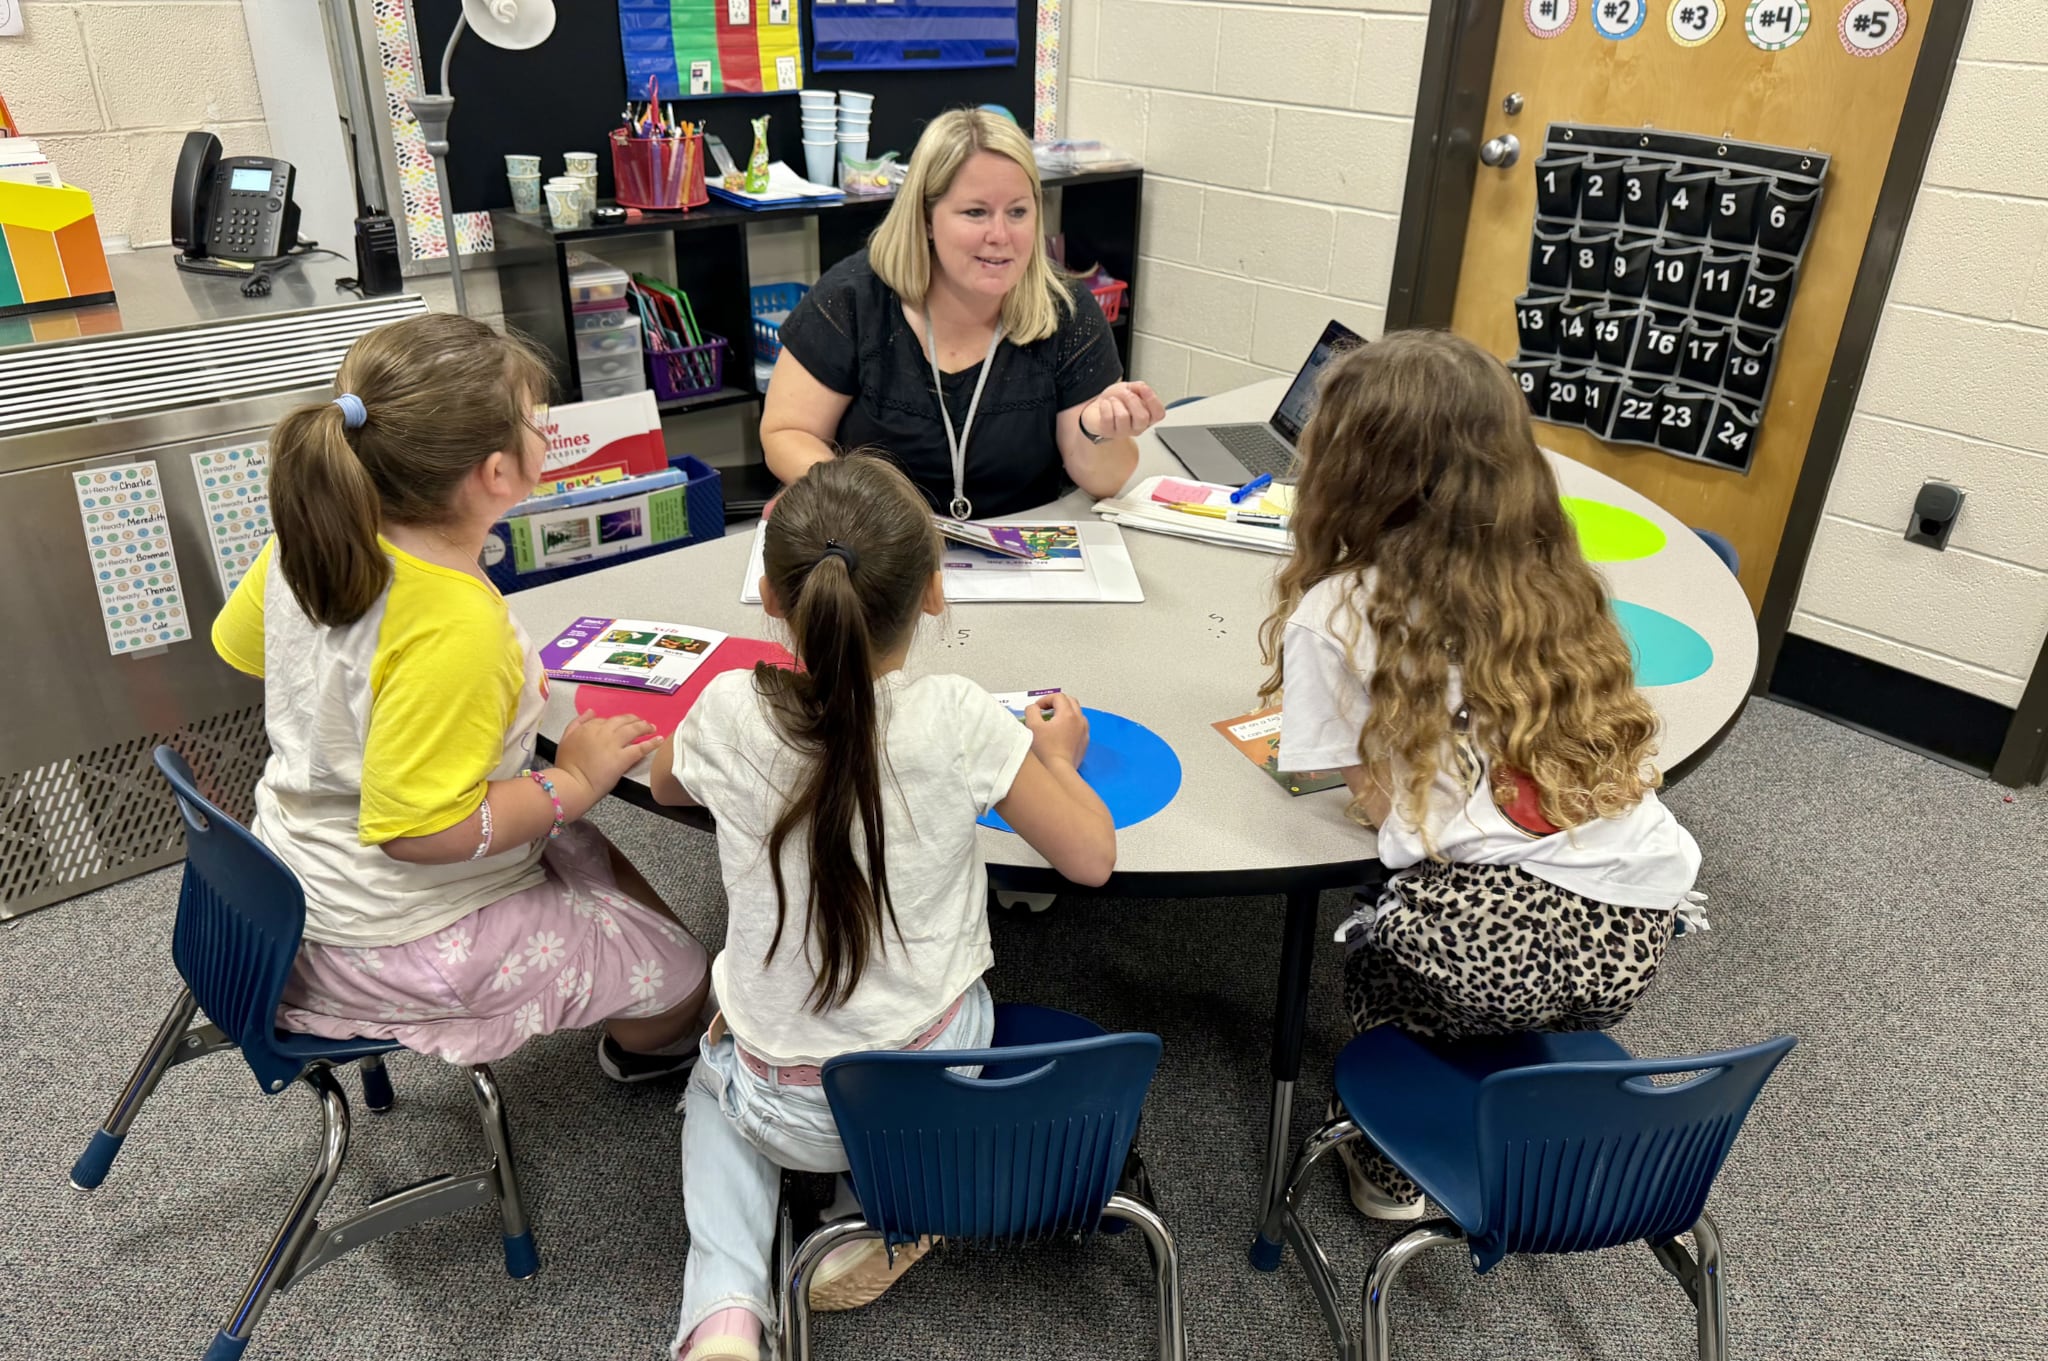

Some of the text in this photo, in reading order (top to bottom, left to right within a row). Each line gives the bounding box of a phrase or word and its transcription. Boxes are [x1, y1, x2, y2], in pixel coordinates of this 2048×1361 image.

[1540, 0, 1558, 20] #1
[1604, 0, 1630, 23] #2
[1680, 6, 1708, 29] #3
[1760, 8, 1792, 32] #4
[1854, 12, 1888, 37] #5
[1545, 172, 1554, 192] 1
[1589, 176, 1602, 196] 2
[1627, 179, 1641, 201] 3
[1672, 189, 1688, 209] 4
[1721, 194, 1735, 215] 5
[1771, 206, 1785, 227] 6
[1542, 246, 1555, 264] 7
[1580, 249, 1593, 268] 8
[1614, 257, 1627, 277] 9
[1655, 260, 1683, 282] 10
[1703, 270, 1729, 291] 11
[1746, 283, 1775, 308] 12
[1518, 309, 1544, 331] 13
[1561, 317, 1584, 337] 14
[1595, 319, 1620, 342] 15
[1647, 329, 1677, 354] 16
[1689, 341, 1718, 361] 17
[1731, 357, 1759, 375] 18
[1551, 383, 1576, 401] 20
[1621, 399, 1653, 419] 22
[1662, 405, 1691, 427] 23
[547, 433, 591, 450] tines
[1718, 421, 1749, 449] 24
[119, 477, 153, 490] Charlie
[127, 513, 166, 527] Meredith
[136, 550, 170, 562] Bowman
[144, 584, 176, 596] Thomas
